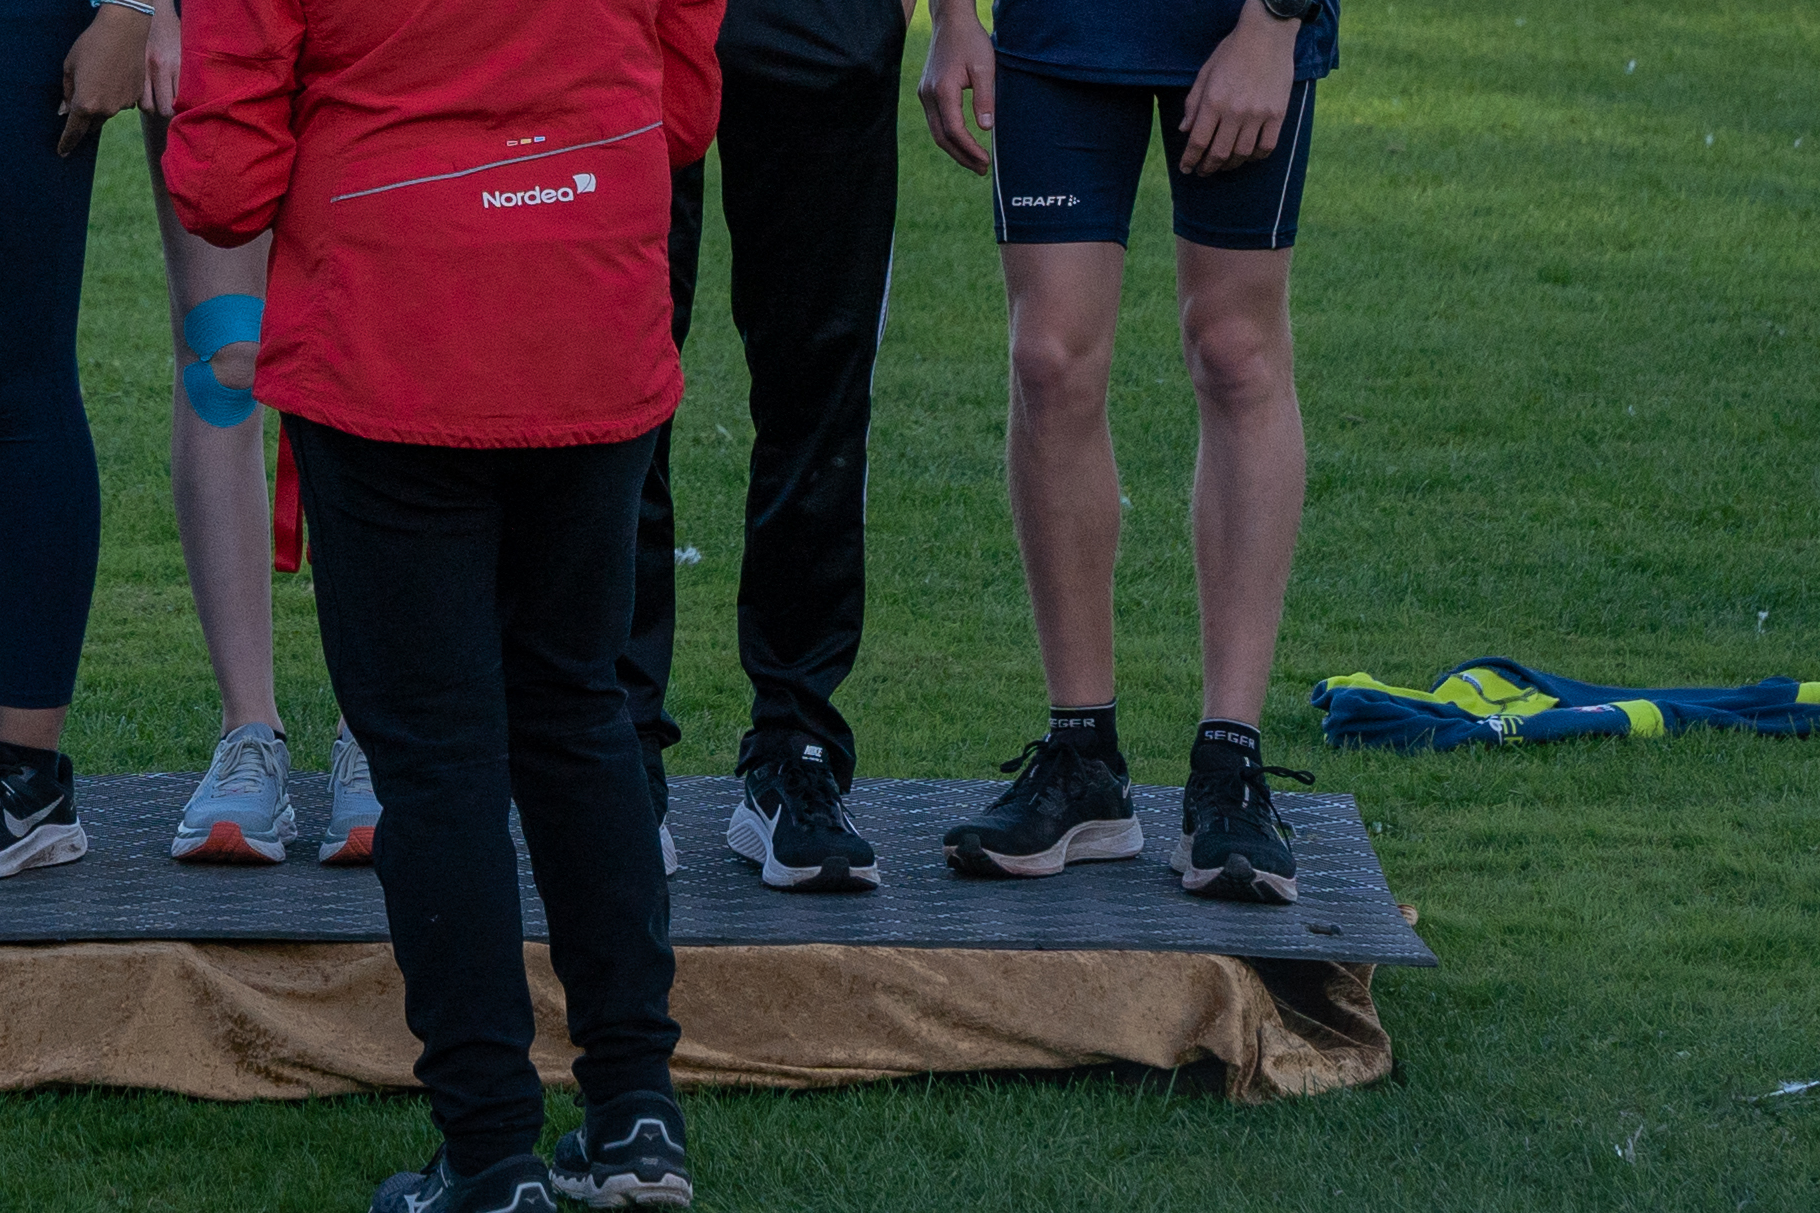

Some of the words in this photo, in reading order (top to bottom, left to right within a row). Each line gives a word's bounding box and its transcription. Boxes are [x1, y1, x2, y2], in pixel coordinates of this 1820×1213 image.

[482, 185, 574, 209] Nordea
[1011, 195, 1067, 207] CRAFT
[1049, 717, 1096, 728] EGER
[1204, 730, 1255, 750] SEGER
